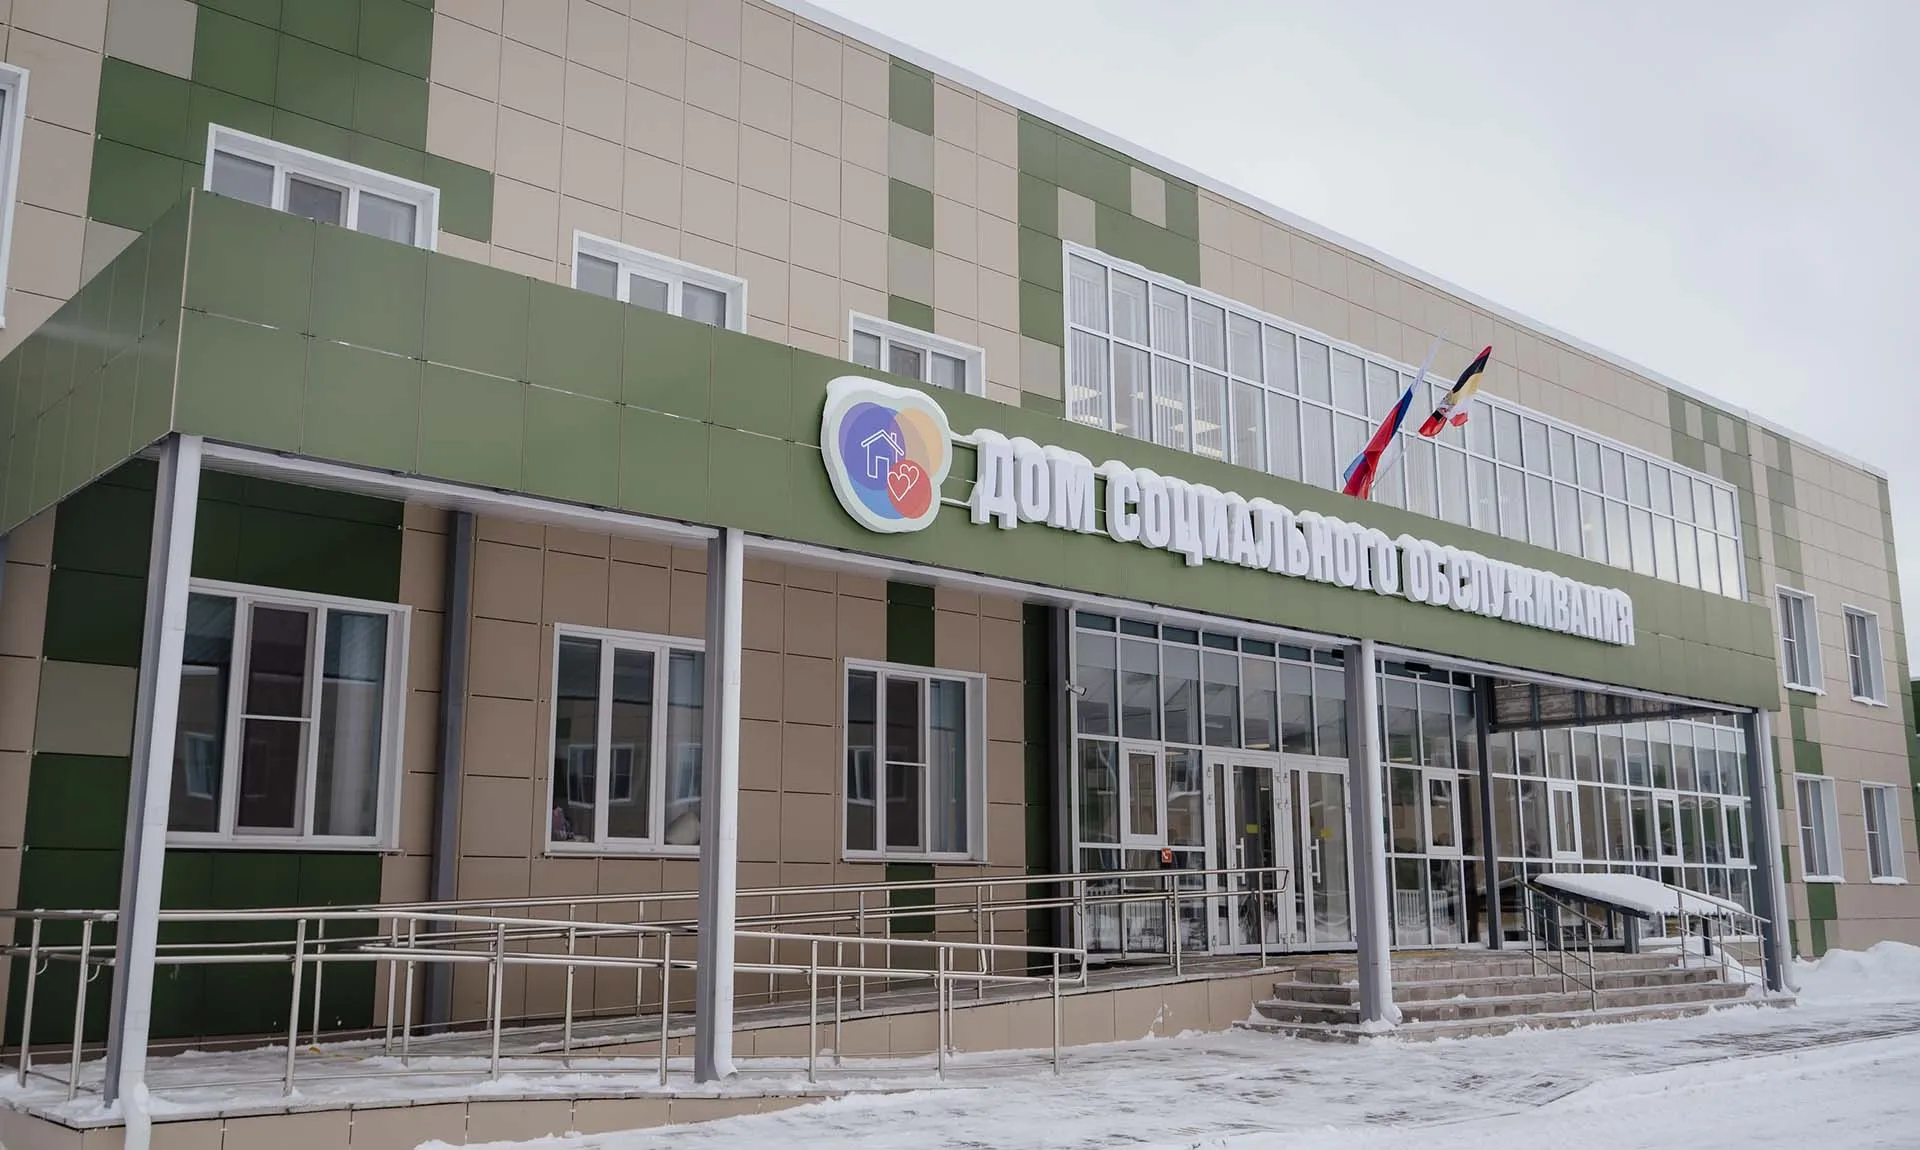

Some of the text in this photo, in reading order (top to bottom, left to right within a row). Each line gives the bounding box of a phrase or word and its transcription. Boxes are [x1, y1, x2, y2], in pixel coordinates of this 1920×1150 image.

[971, 436, 1636, 646] ДОМ СОЦИАЛЬНОГО ОБСЛУЖИВАНИЯ
